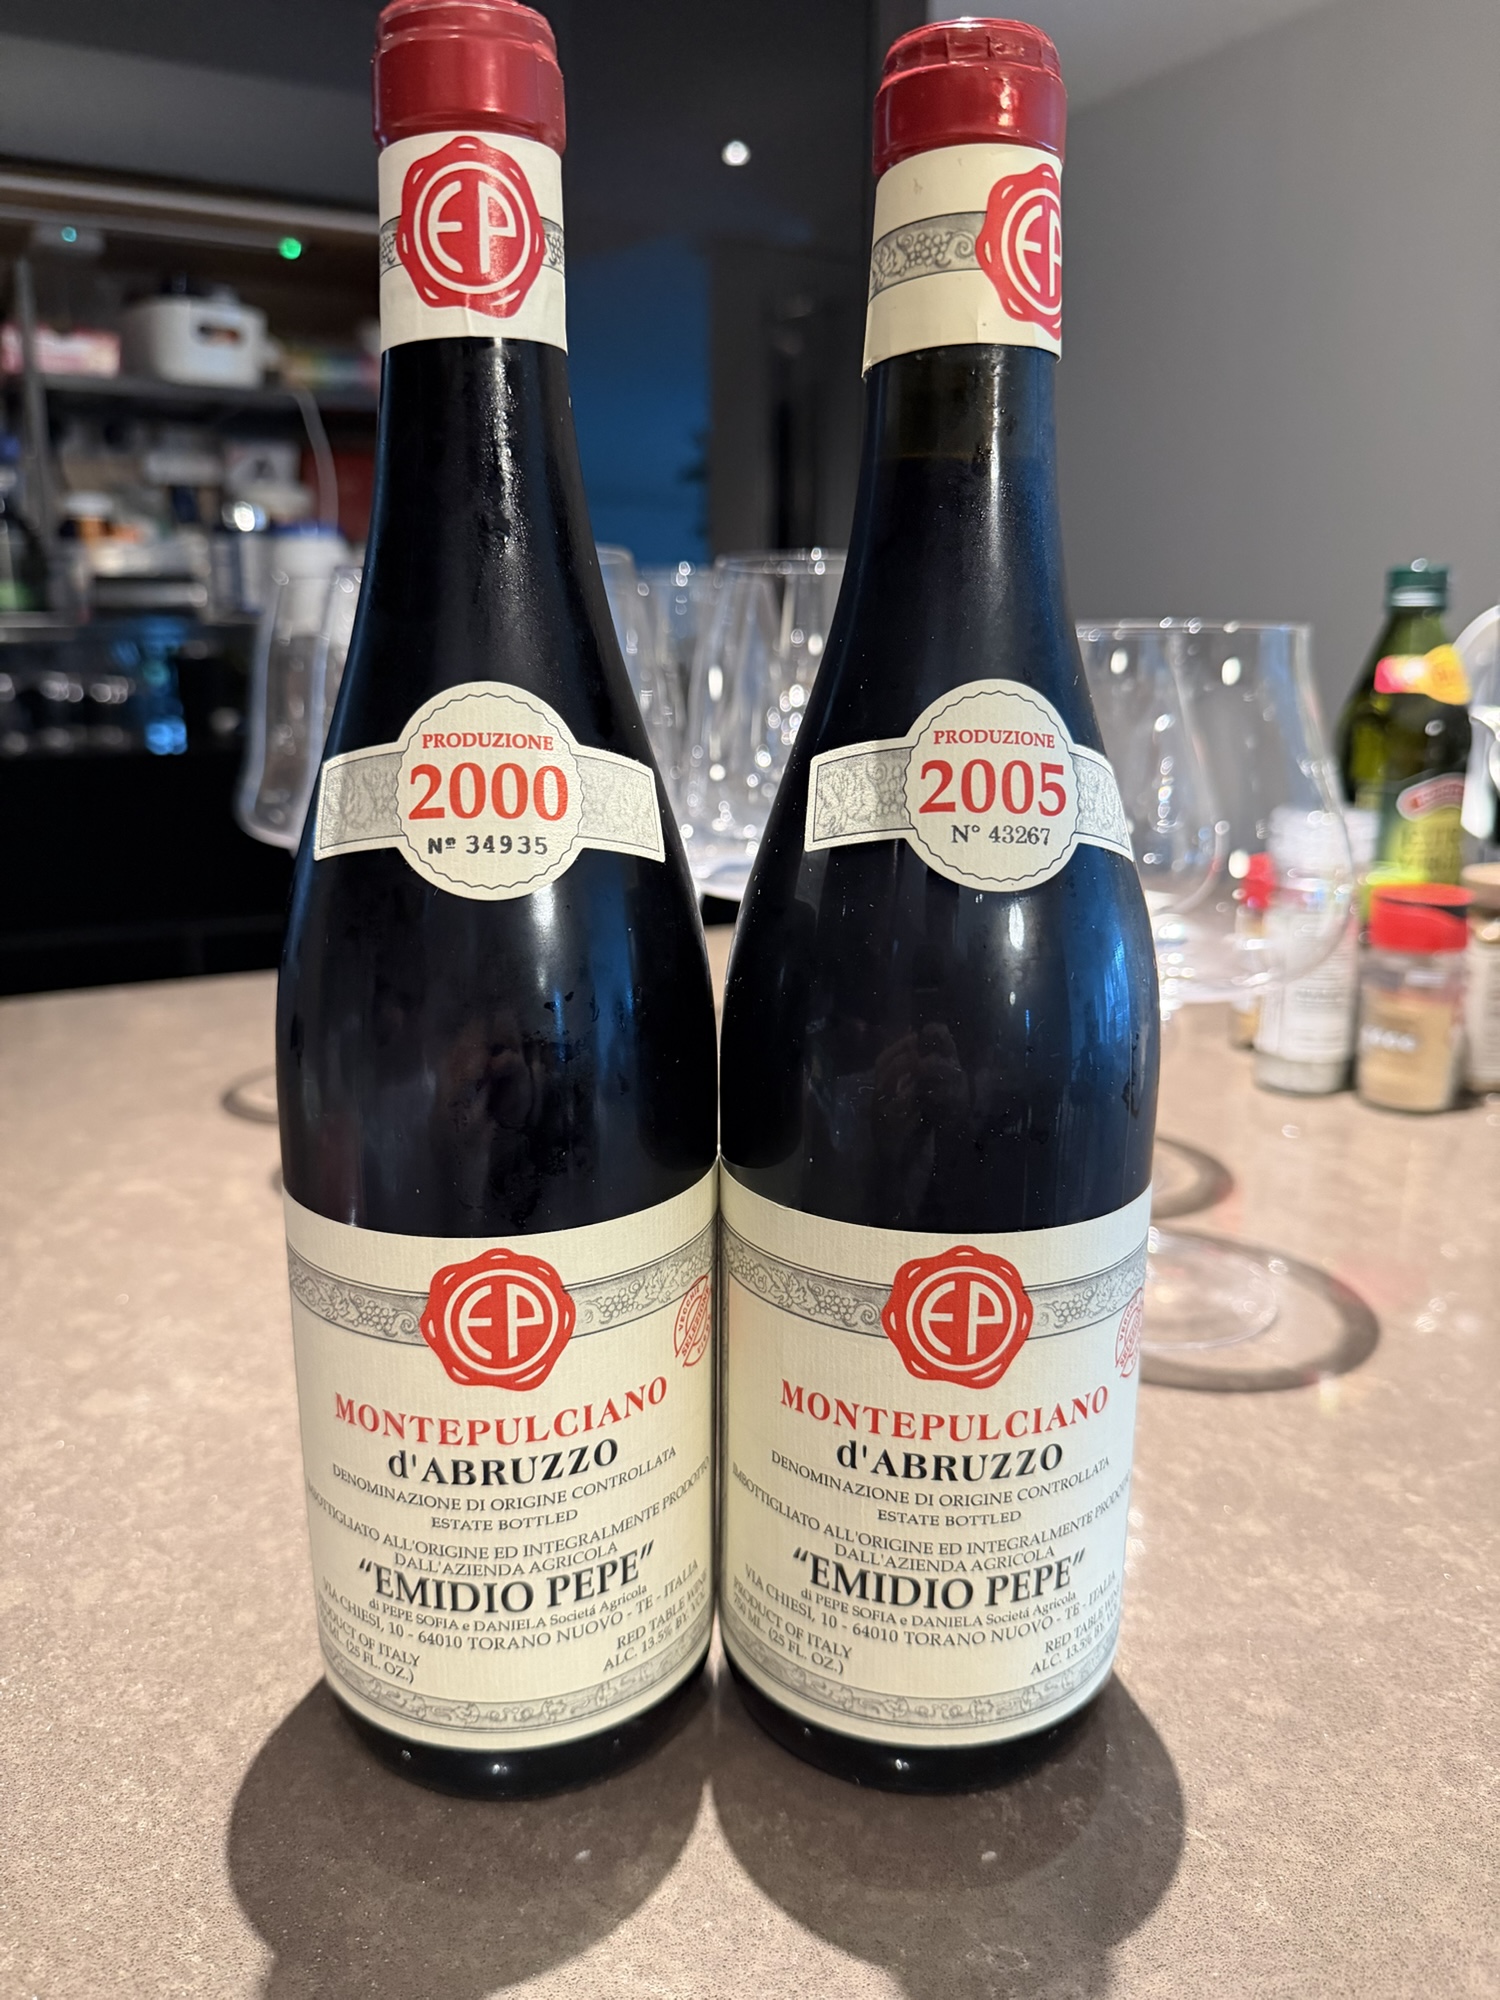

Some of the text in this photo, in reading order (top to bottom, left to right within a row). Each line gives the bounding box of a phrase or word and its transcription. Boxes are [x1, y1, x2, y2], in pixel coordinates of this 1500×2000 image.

[427, 180, 518, 275] EP
[421, 732, 554, 751] PRODUZIONE
[932, 729, 1056, 749] PRODUZIONE
[408, 761, 568, 821] 2000
[918, 758, 1067, 817] 2005
[465, 835, 549, 855] 34935
[988, 824, 1051, 846] 43267
[458, 1282, 545, 1361] EP
[920, 1280, 1004, 1356] EP
[335, 1375, 668, 1447] MONTEPULCIANO
[780, 1379, 1109, 1443] MONTEPULCIANO
[332, 1446, 676, 1511] DENOMINAZIONE DI ORIGINE CONTROLLATA
[388, 1437, 619, 1486] d'ABRUZZO
[771, 1449, 1109, 1507] DENOMINAZIONE DI ORIGINE CONTROLLATA
[836, 1439, 1063, 1482] d'ABRUZZO
[383, 1533, 490, 1560] ALL'ORIGINE
[494, 1545, 519, 1560] ED
[523, 1502, 660, 1557] INTEGRALMENTE
[431, 1509, 578, 1531] ESTATE BOTTLED
[823, 1523, 934, 1555] ALL'ORIGINE
[938, 1542, 962, 1556] ED
[967, 1509, 1093, 1555] INTEGRALMENTE
[877, 1508, 1022, 1527] ESTATE BOTTLED
[394, 1541, 618, 1577] DALL'AZIENDA AGRICOLA
[834, 1543, 1056, 1573] DALL'AZIENDA AGRICOLA
[340, 1594, 385, 1633] CHIESI,
[388, 1621, 405, 1638] 10
[418, 1630, 463, 1650] 64010
[467, 1632, 551, 1651] TORANO
[556, 1610, 624, 1644] NUOVO
[636, 1595, 654, 1615] TE
[664, 1559, 698, 1599] ITALIA
[369, 1597, 380, 1612] di
[382, 1603, 413, 1622] PEPE
[416, 1613, 460, 1630] SOFIA
[462, 1621, 471, 1631] e
[474, 1617, 547, 1632] DANIELA
[600, 1583, 647, 1613] Agricola
[615, 1625, 647, 1651] RED
[649, 1595, 686, 1633] TABLE
[745, 1562, 765, 1592] VIA
[766, 1583, 816, 1623] CHIESI,
[821, 1612, 837, 1629] 10
[852, 1622, 899, 1643] 64010
[903, 1630, 986, 1647] TORANO
[990, 1615, 1054, 1643] NUOVO
[1064, 1601, 1080, 1620] TE
[1088, 1570, 1115, 1606] ITALIA
[801, 1587, 812, 1601] di
[815, 1592, 849, 1614] PEPE
[852, 1605, 896, 1625] SOFIA
[900, 1615, 908, 1625] e
[911, 1614, 983, 1628] DANIELA
[1033, 1591, 1076, 1616] Agricola
[345, 1638, 362, 1659] (25
[363, 1650, 381, 1670] FL.
[384, 1660, 415, 1685] OZ.)
[359, 1632, 376, 1650] OF
[378, 1642, 420, 1668] ITALY
[602, 1648, 638, 1673] ALC.
[641, 1620, 673, 1653] 13.5%
[768, 1626, 786, 1648] (25
[788, 1640, 808, 1661] FL.
[811, 1651, 844, 1676] OZ.)
[785, 1621, 804, 1640] OF
[807, 1631, 852, 1660] ITALY
[1030, 1653, 1062, 1676] ALC.
[1044, 1631, 1072, 1654] RED
